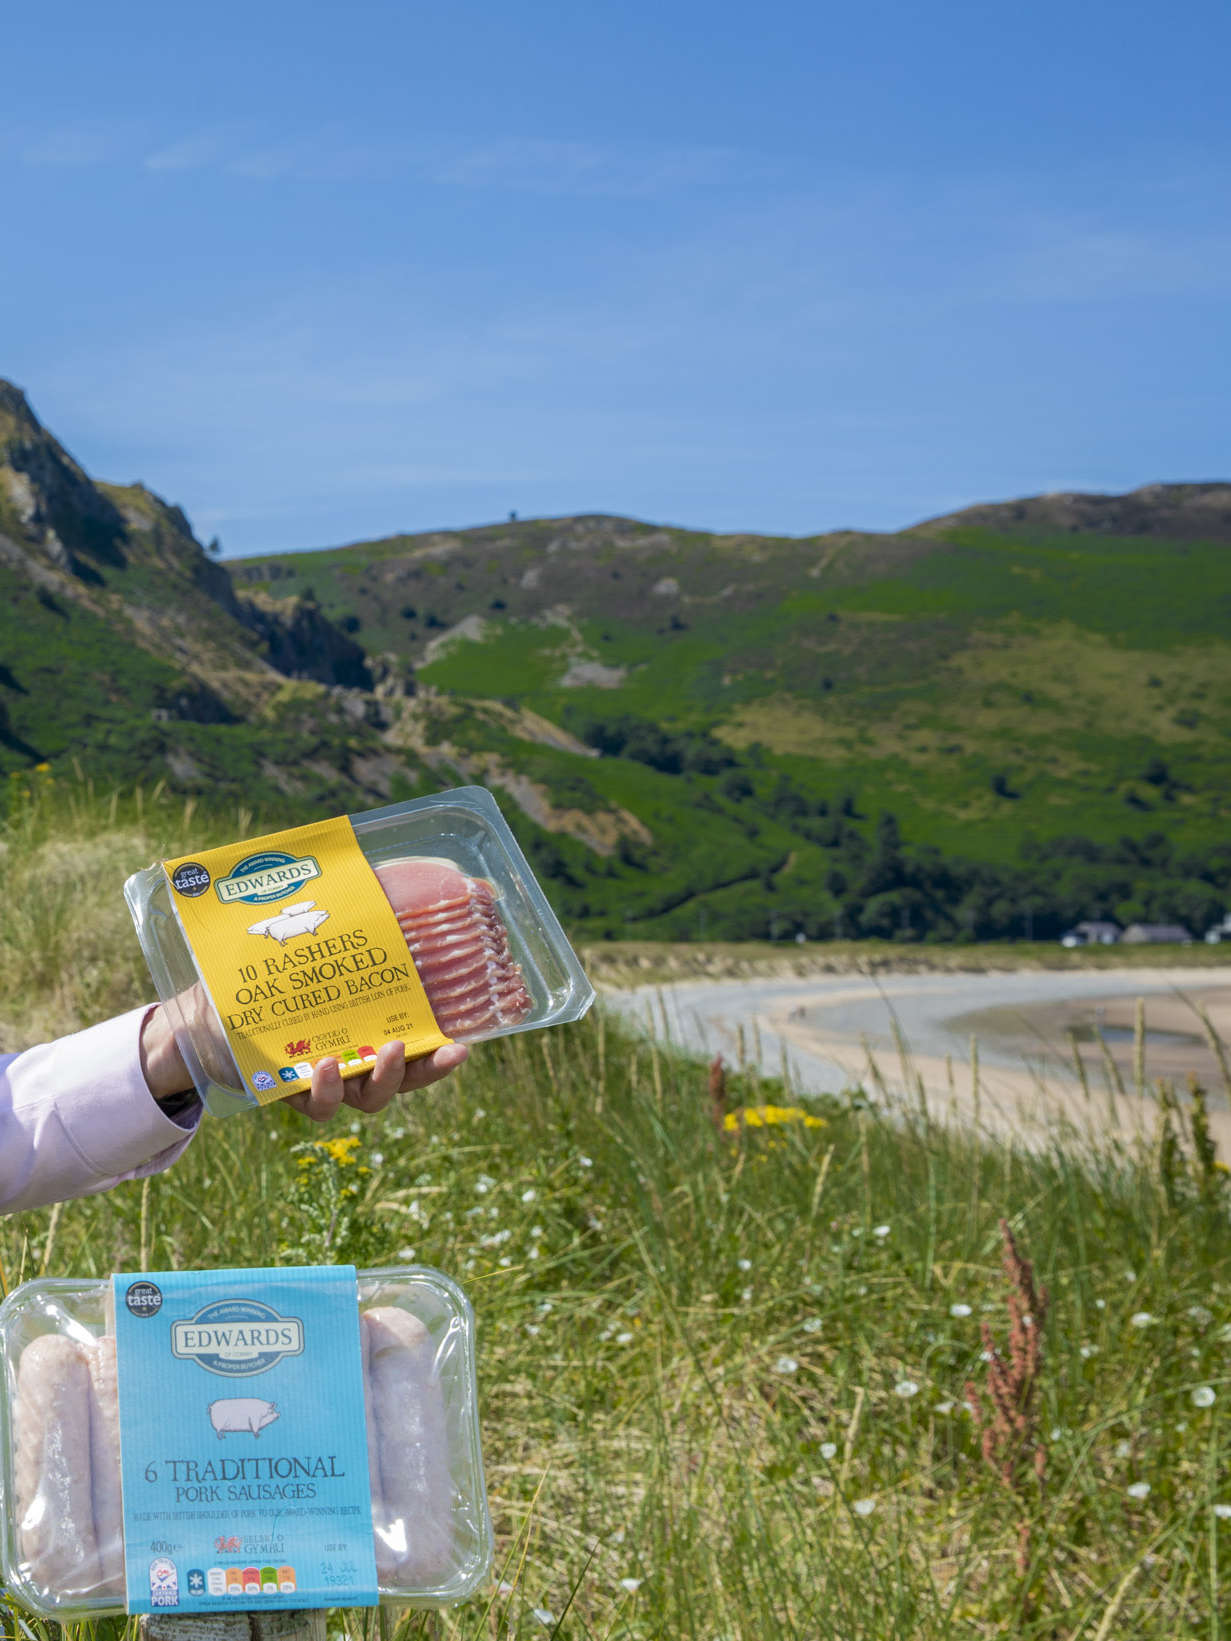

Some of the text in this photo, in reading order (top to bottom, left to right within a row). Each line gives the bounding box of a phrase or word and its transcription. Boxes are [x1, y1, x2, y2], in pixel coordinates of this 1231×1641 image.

[181, 868, 198, 878] great
[175, 873, 209, 889] taste
[224, 864, 311, 896] EDWARDS
[238, 929, 368, 983] 10 RASHERS
[236, 947, 387, 1004] OAK SMOKED
[227, 963, 409, 1030] DRY CURED BACON
[236, 1021, 282, 1040] TRADITIONALLY
[282, 1014, 303, 1026] CURED
[303, 1013, 310, 1021] BY
[311, 1007, 330, 1018] HAND
[330, 1002, 348, 1013] USING
[348, 996, 371, 1008] BRITISH
[371, 991, 385, 1000] LOIN
[386, 988, 393, 996] OF
[386, 1014, 398, 1023] USE
[312, 1030, 340, 1042] CIGYDD
[392, 1025, 405, 1034] AUG
[316, 1035, 351, 1050] GYMRU
[134, 1288, 152, 1296] great
[127, 1294, 161, 1306] taste
[208, 1306, 265, 1320] THE AWARD WINNING
[184, 1328, 292, 1348] EDWARDS
[218, 1362, 240, 1370] PROPER
[241, 1359, 266, 1370] BUTCHER
[145, 1456, 345, 1483] 6 TRADITIONAL
[176, 1483, 316, 1503] PORK SAUSAGES
[153, 1512, 170, 1520] WITH
[231, 1510, 239, 1518] OF
[240, 1509, 256, 1518] PORK
[258, 1508, 267, 1517] TO
[268, 1508, 283, 1517] OUR
[340, 1506, 362, 1515] RECIPE
[277, 1534, 284, 1542] O
[244, 1543, 284, 1554] GYMRU
[324, 1544, 337, 1552] USE
[320, 1561, 358, 1574] 24 JUL
[152, 1596, 178, 1606] PORK
